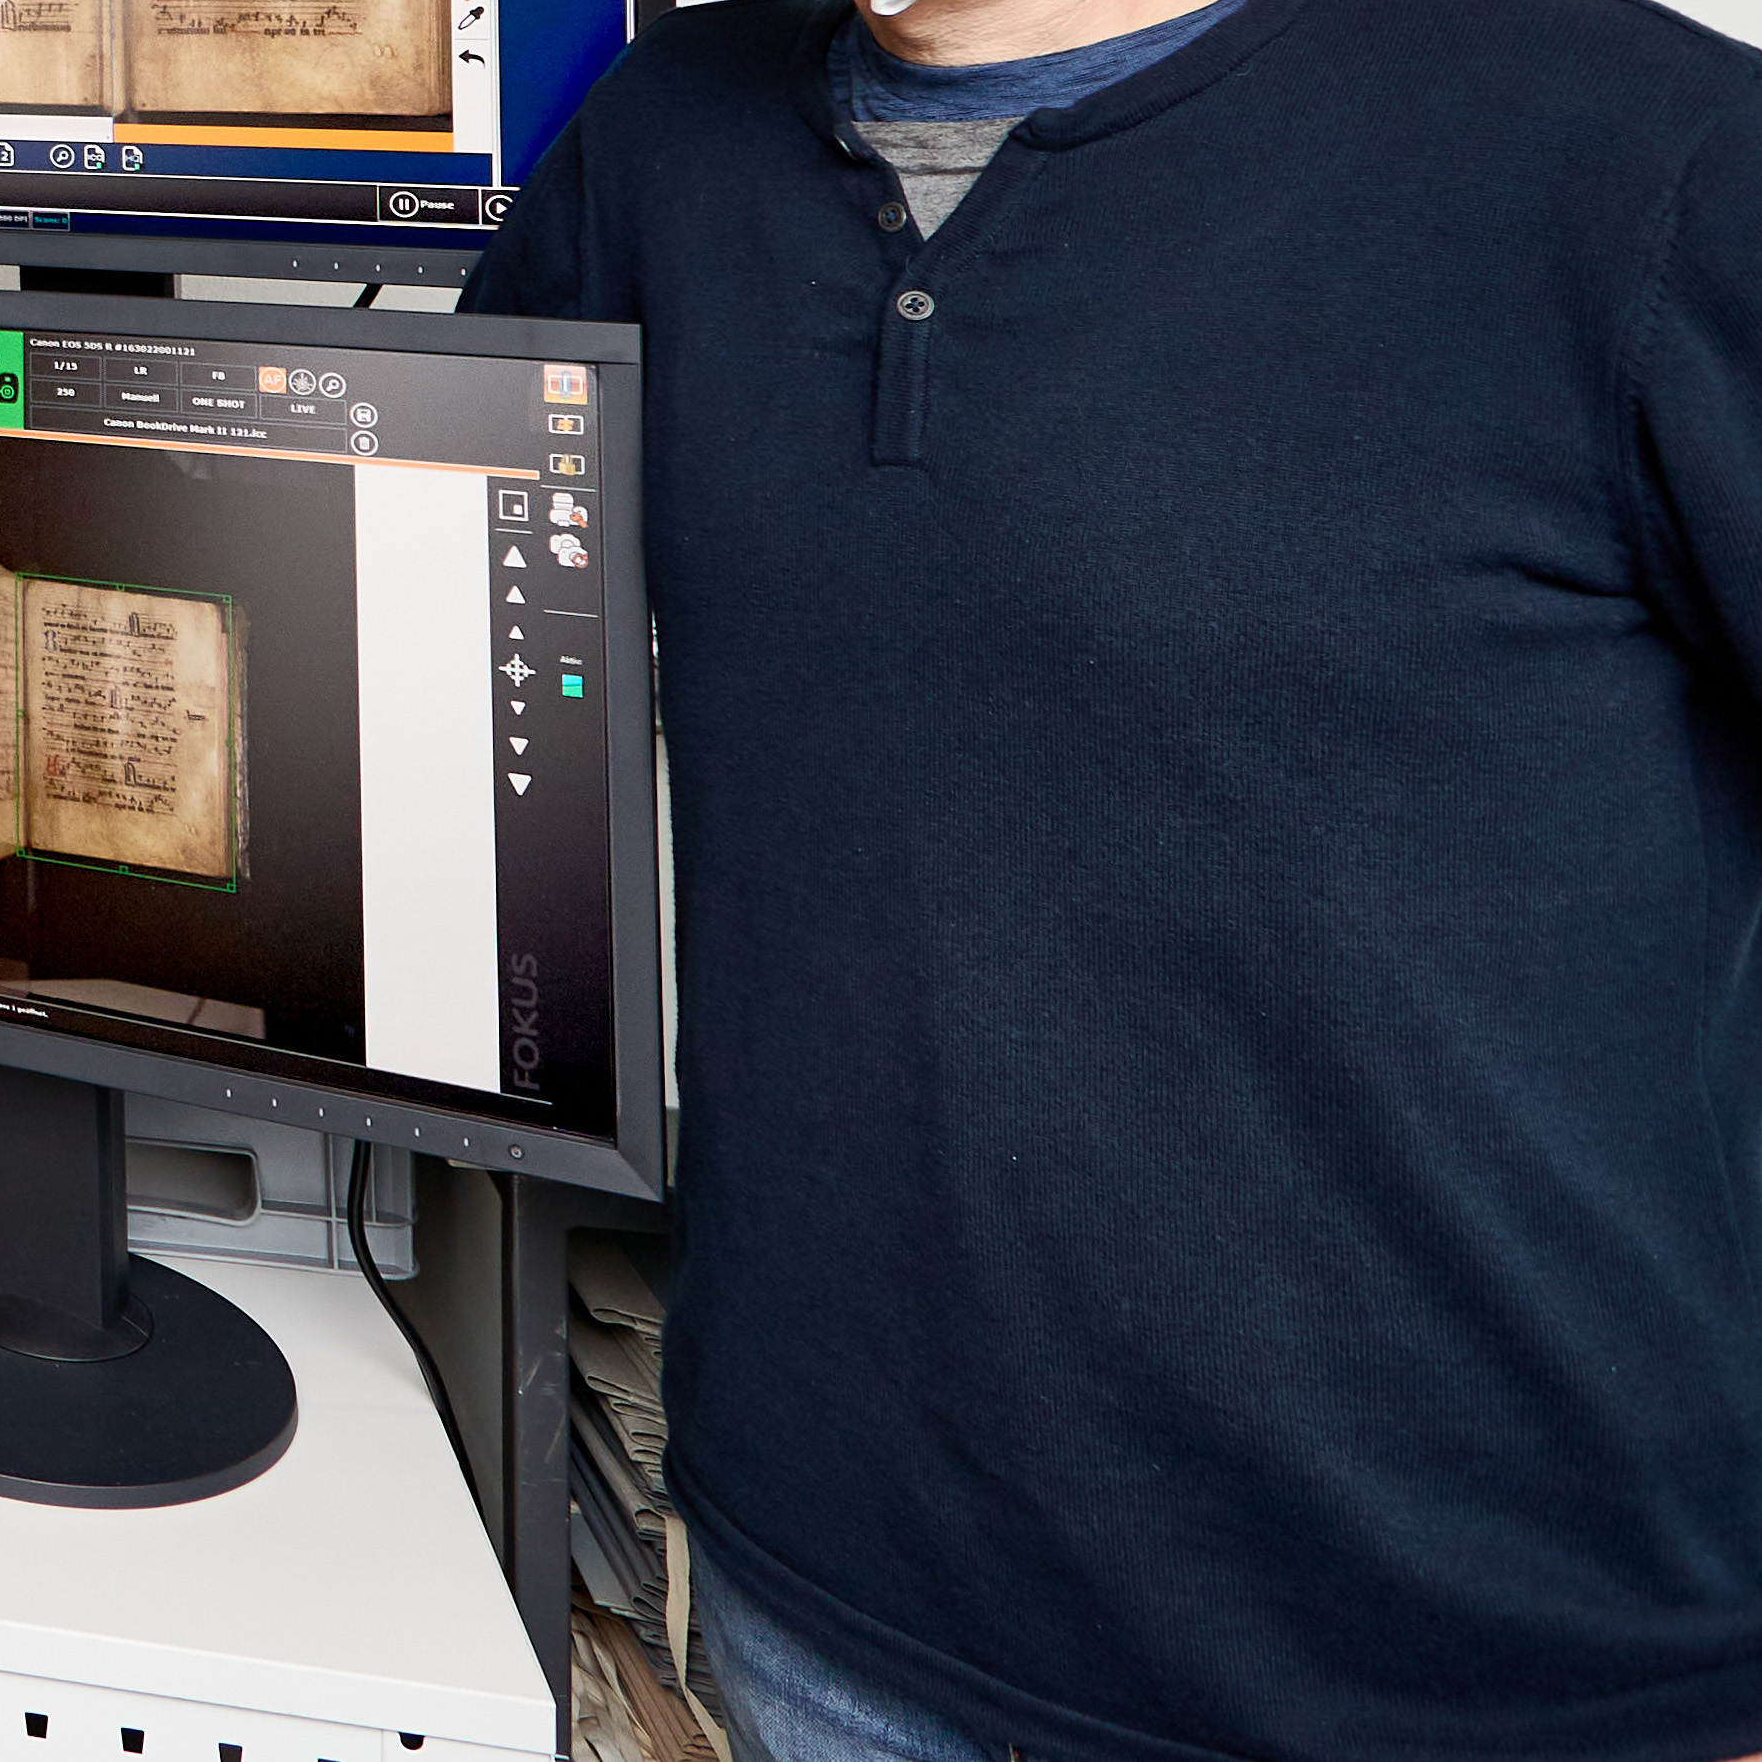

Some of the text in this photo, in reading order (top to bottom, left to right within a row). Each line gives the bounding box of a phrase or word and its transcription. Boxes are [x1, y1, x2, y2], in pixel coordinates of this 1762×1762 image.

[419, 198, 455, 212] Pause
[30, 338, 60, 349] Canon
[61, 340, 82, 350] EOS
[291, 404, 316, 414] LIVE
[104, 418, 134, 429] Canon
[512, 951, 540, 1093] FOKUS
